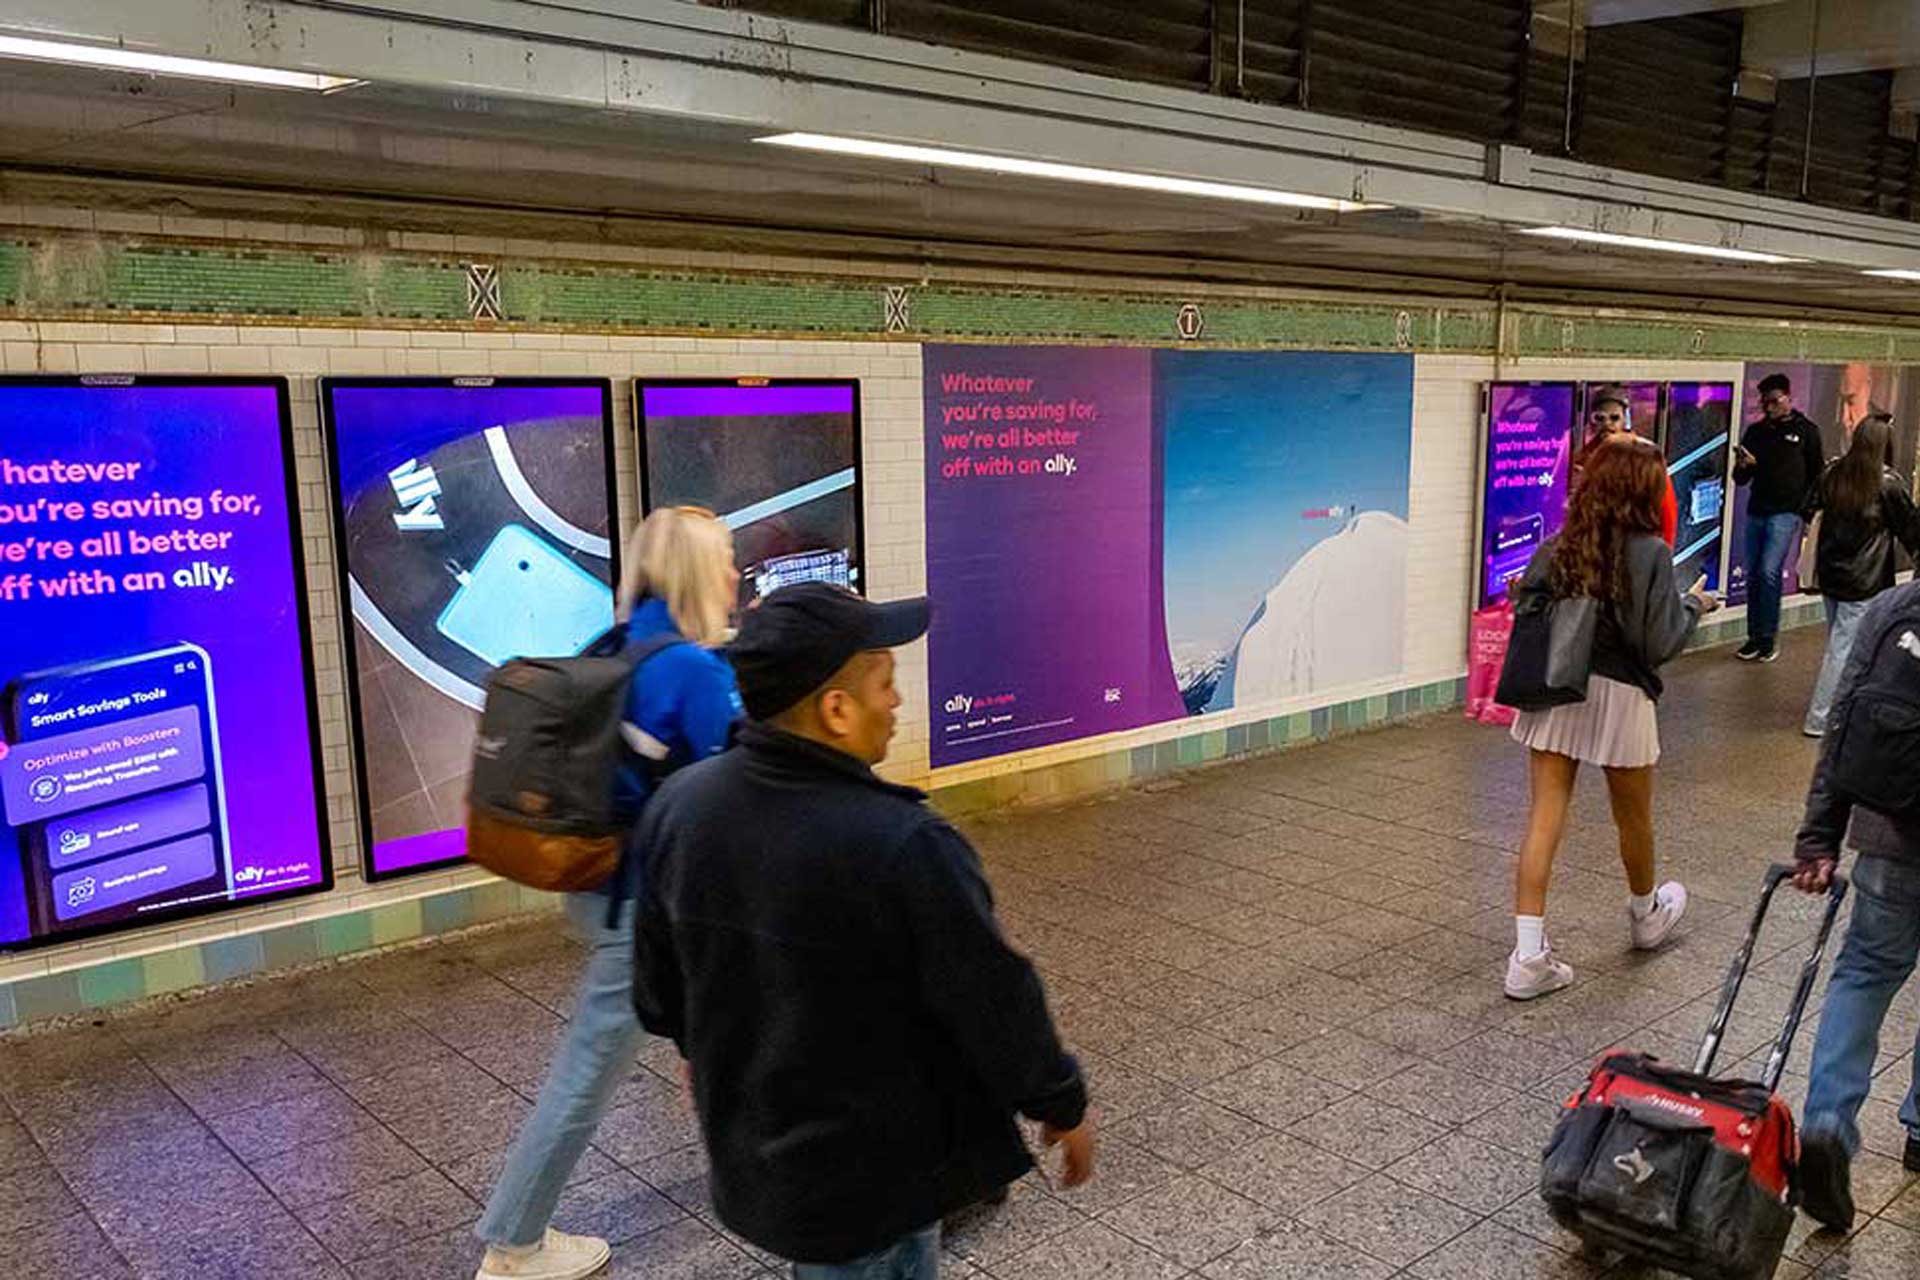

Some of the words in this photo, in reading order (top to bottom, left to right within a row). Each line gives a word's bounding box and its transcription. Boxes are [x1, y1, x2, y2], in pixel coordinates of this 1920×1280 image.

[941, 372, 1034, 393] Whatever
[942, 403, 1001, 425] you're
[1005, 400, 1065, 422] saving
[1069, 398, 1097, 421] for,
[942, 430, 994, 449] we're
[998, 428, 1020, 447] all
[1024, 428, 1079, 446] better
[0, 459, 141, 484] hatever
[942, 457, 970, 477] off
[974, 455, 1014, 476] with
[1017, 458, 1041, 474] an
[1045, 453, 1077, 476] ally.
[0, 498, 84, 523] ou're
[92, 492, 203, 520] saving
[209, 489, 263, 517] for,
[0, 537, 74, 562] e're
[81, 531, 122, 558] all
[129, 528, 233, 555] better
[0, 573, 33, 600] ff
[39, 570, 115, 598] with
[122, 572, 166, 592] an
[173, 562, 235, 591] ally.
[28, 692, 49, 705] ally
[31, 708, 76, 728] Smart
[77, 697, 131, 718] Savings
[132, 688, 167, 705] Tools
[944, 694, 972, 713] ally
[24, 748, 90, 772] Optimize
[91, 739, 122, 755] with
[123, 727, 181, 748] Boosters
[235, 866, 264, 882] ally
